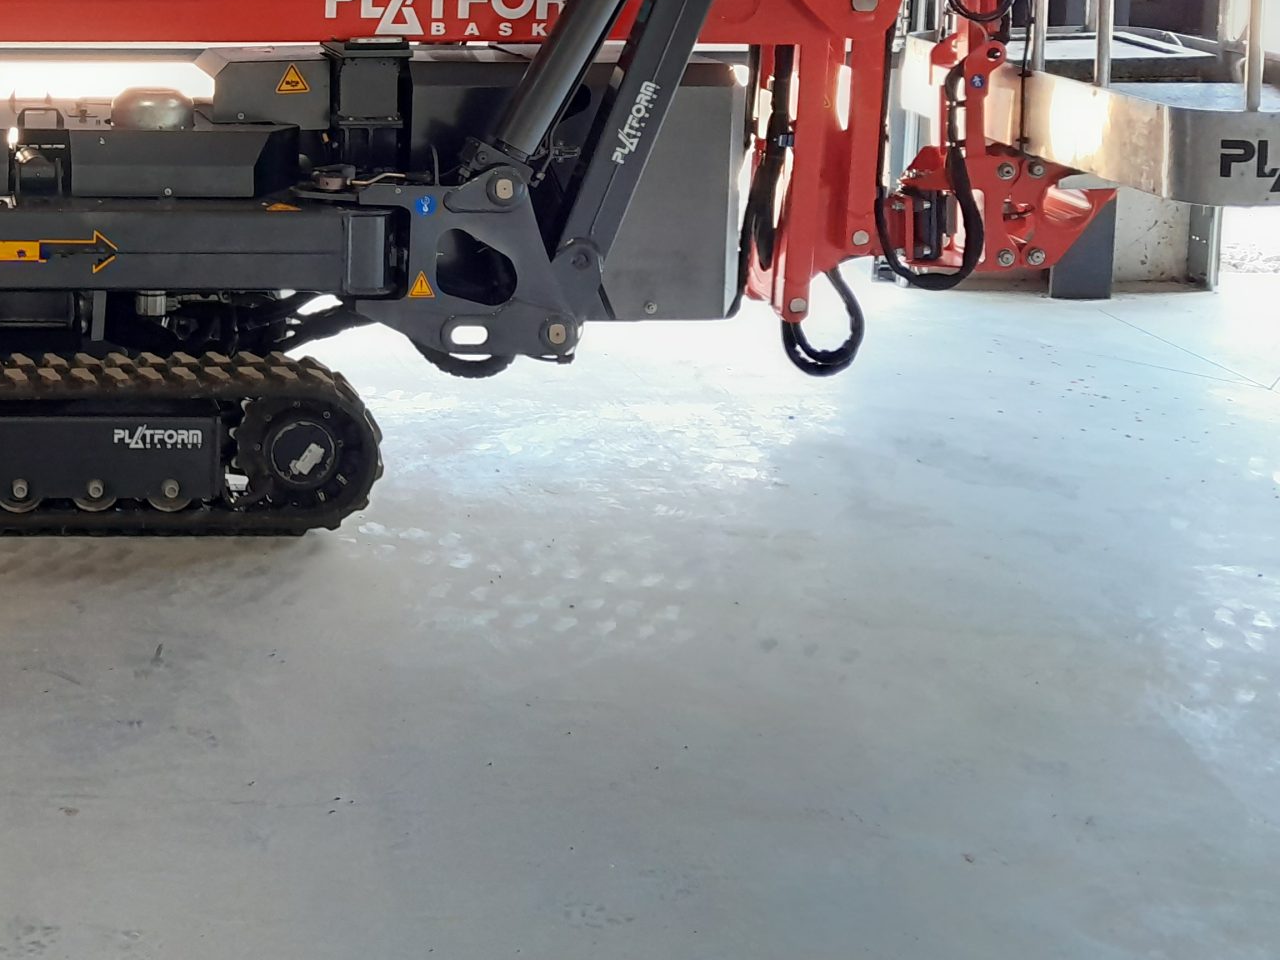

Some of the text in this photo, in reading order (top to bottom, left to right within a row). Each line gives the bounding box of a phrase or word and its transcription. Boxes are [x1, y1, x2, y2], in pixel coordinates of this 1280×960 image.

[431, 22, 548, 36] BASK
[611, 81, 658, 165] PLATFORM
[1220, 139, 1280, 193] PL
[113, 424, 203, 449] PLATFORM
